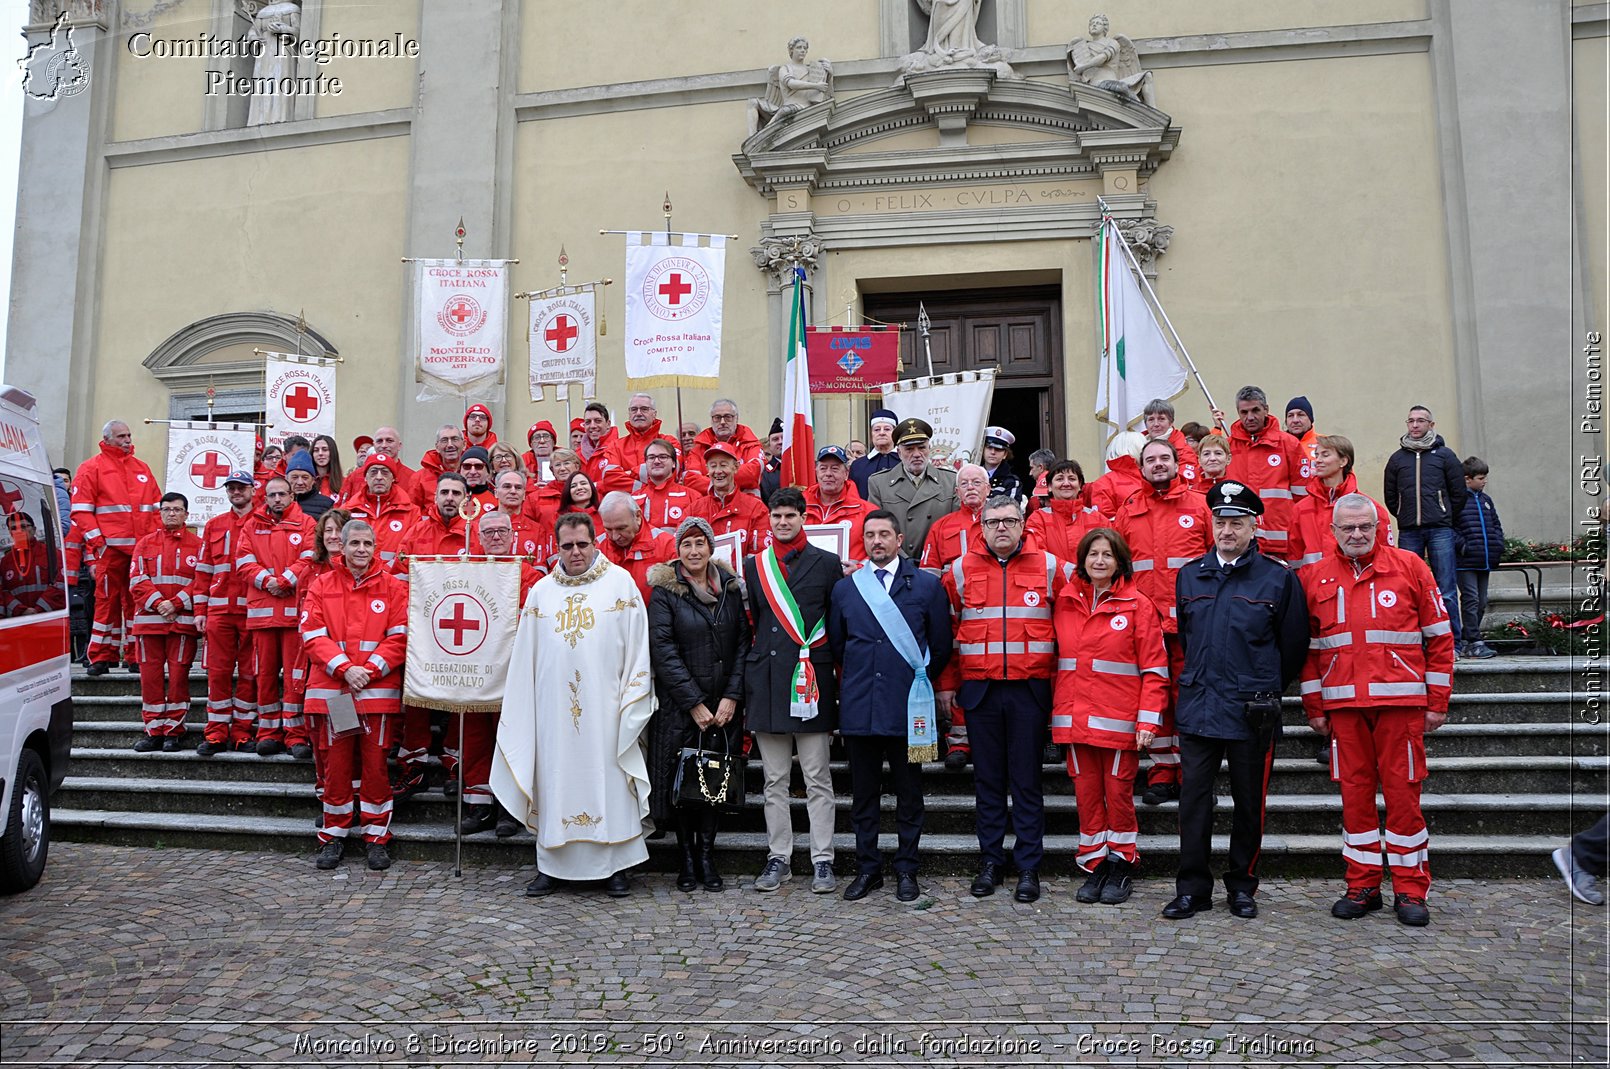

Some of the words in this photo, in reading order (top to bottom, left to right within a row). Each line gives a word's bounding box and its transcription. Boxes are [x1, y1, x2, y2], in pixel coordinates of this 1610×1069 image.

[1114, 177, 1128, 191] Q
[787, 194, 798, 209] S
[837, 199, 851, 213] O
[875, 194, 933, 211] FELIX
[957, 189, 1032, 206] CVLPA
[429, 268, 461, 278] CROCE
[467, 269, 498, 278] ROSSA
[440, 279, 487, 288] ITALIANA
[533, 310, 547, 332] CROCE
[547, 299, 567, 313] ROSSA
[568, 299, 591, 327] ITALIANA
[633, 338, 654, 346] Croce
[655, 334, 681, 342] Rossa
[683, 333, 711, 341] Italiana
[430, 346, 491, 355] MONTIGLIO
[646, 346, 684, 355] COMITATO
[424, 355, 496, 364] MONFERRATO
[541, 358, 566, 368] GRUPPO
[269, 375, 286, 399] CROCE
[284, 369, 310, 380] ROSSA
[310, 373, 332, 405] ITALIANA
[826, 381, 874, 389] MONCALVO
[933, 426, 960, 435] CALVO
[174, 442, 194, 465] CROCE
[194, 435, 219, 446] ROSSA
[221, 437, 247, 468] ITALIANA
[194, 495, 225, 505] GRUPPO
[423, 590, 440, 618] CROCE
[442, 579, 470, 592] ROSSA
[474, 584, 500, 622] ITALIANA
[424, 662, 479, 674] DELEGAZIONE
[485, 665, 493, 674] DI
[432, 675, 485, 688] MONCALVO
